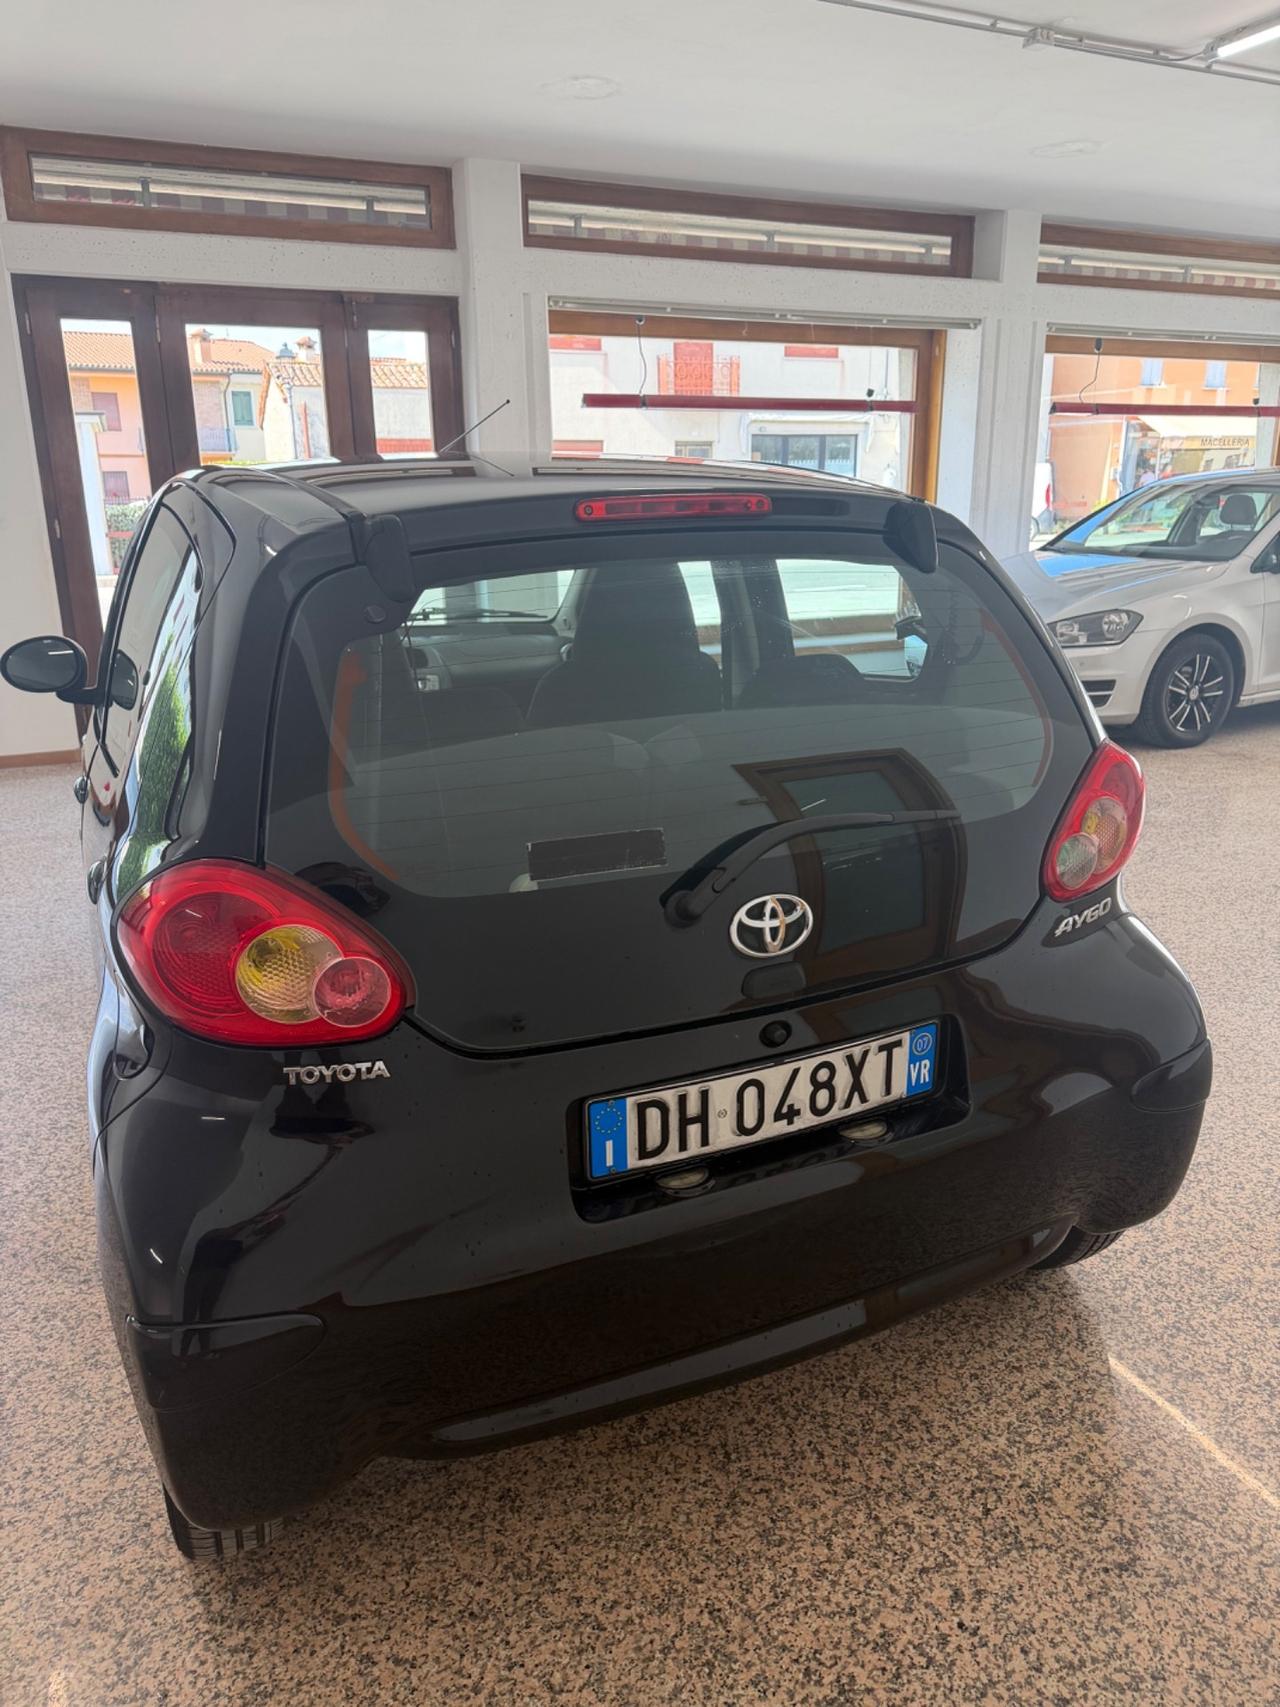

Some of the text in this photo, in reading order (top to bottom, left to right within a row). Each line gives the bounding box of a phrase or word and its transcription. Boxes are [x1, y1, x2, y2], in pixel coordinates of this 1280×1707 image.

[1200, 437, 1250, 448] MACELLERIA
[1054, 897, 1112, 938] AYGO
[916, 1036, 930, 1052] 07
[283, 1060, 391, 1086] TOYOTA
[910, 1059, 930, 1087] VR
[637, 1039, 902, 1160] DH 048XT
[605, 1139, 613, 1167] I
